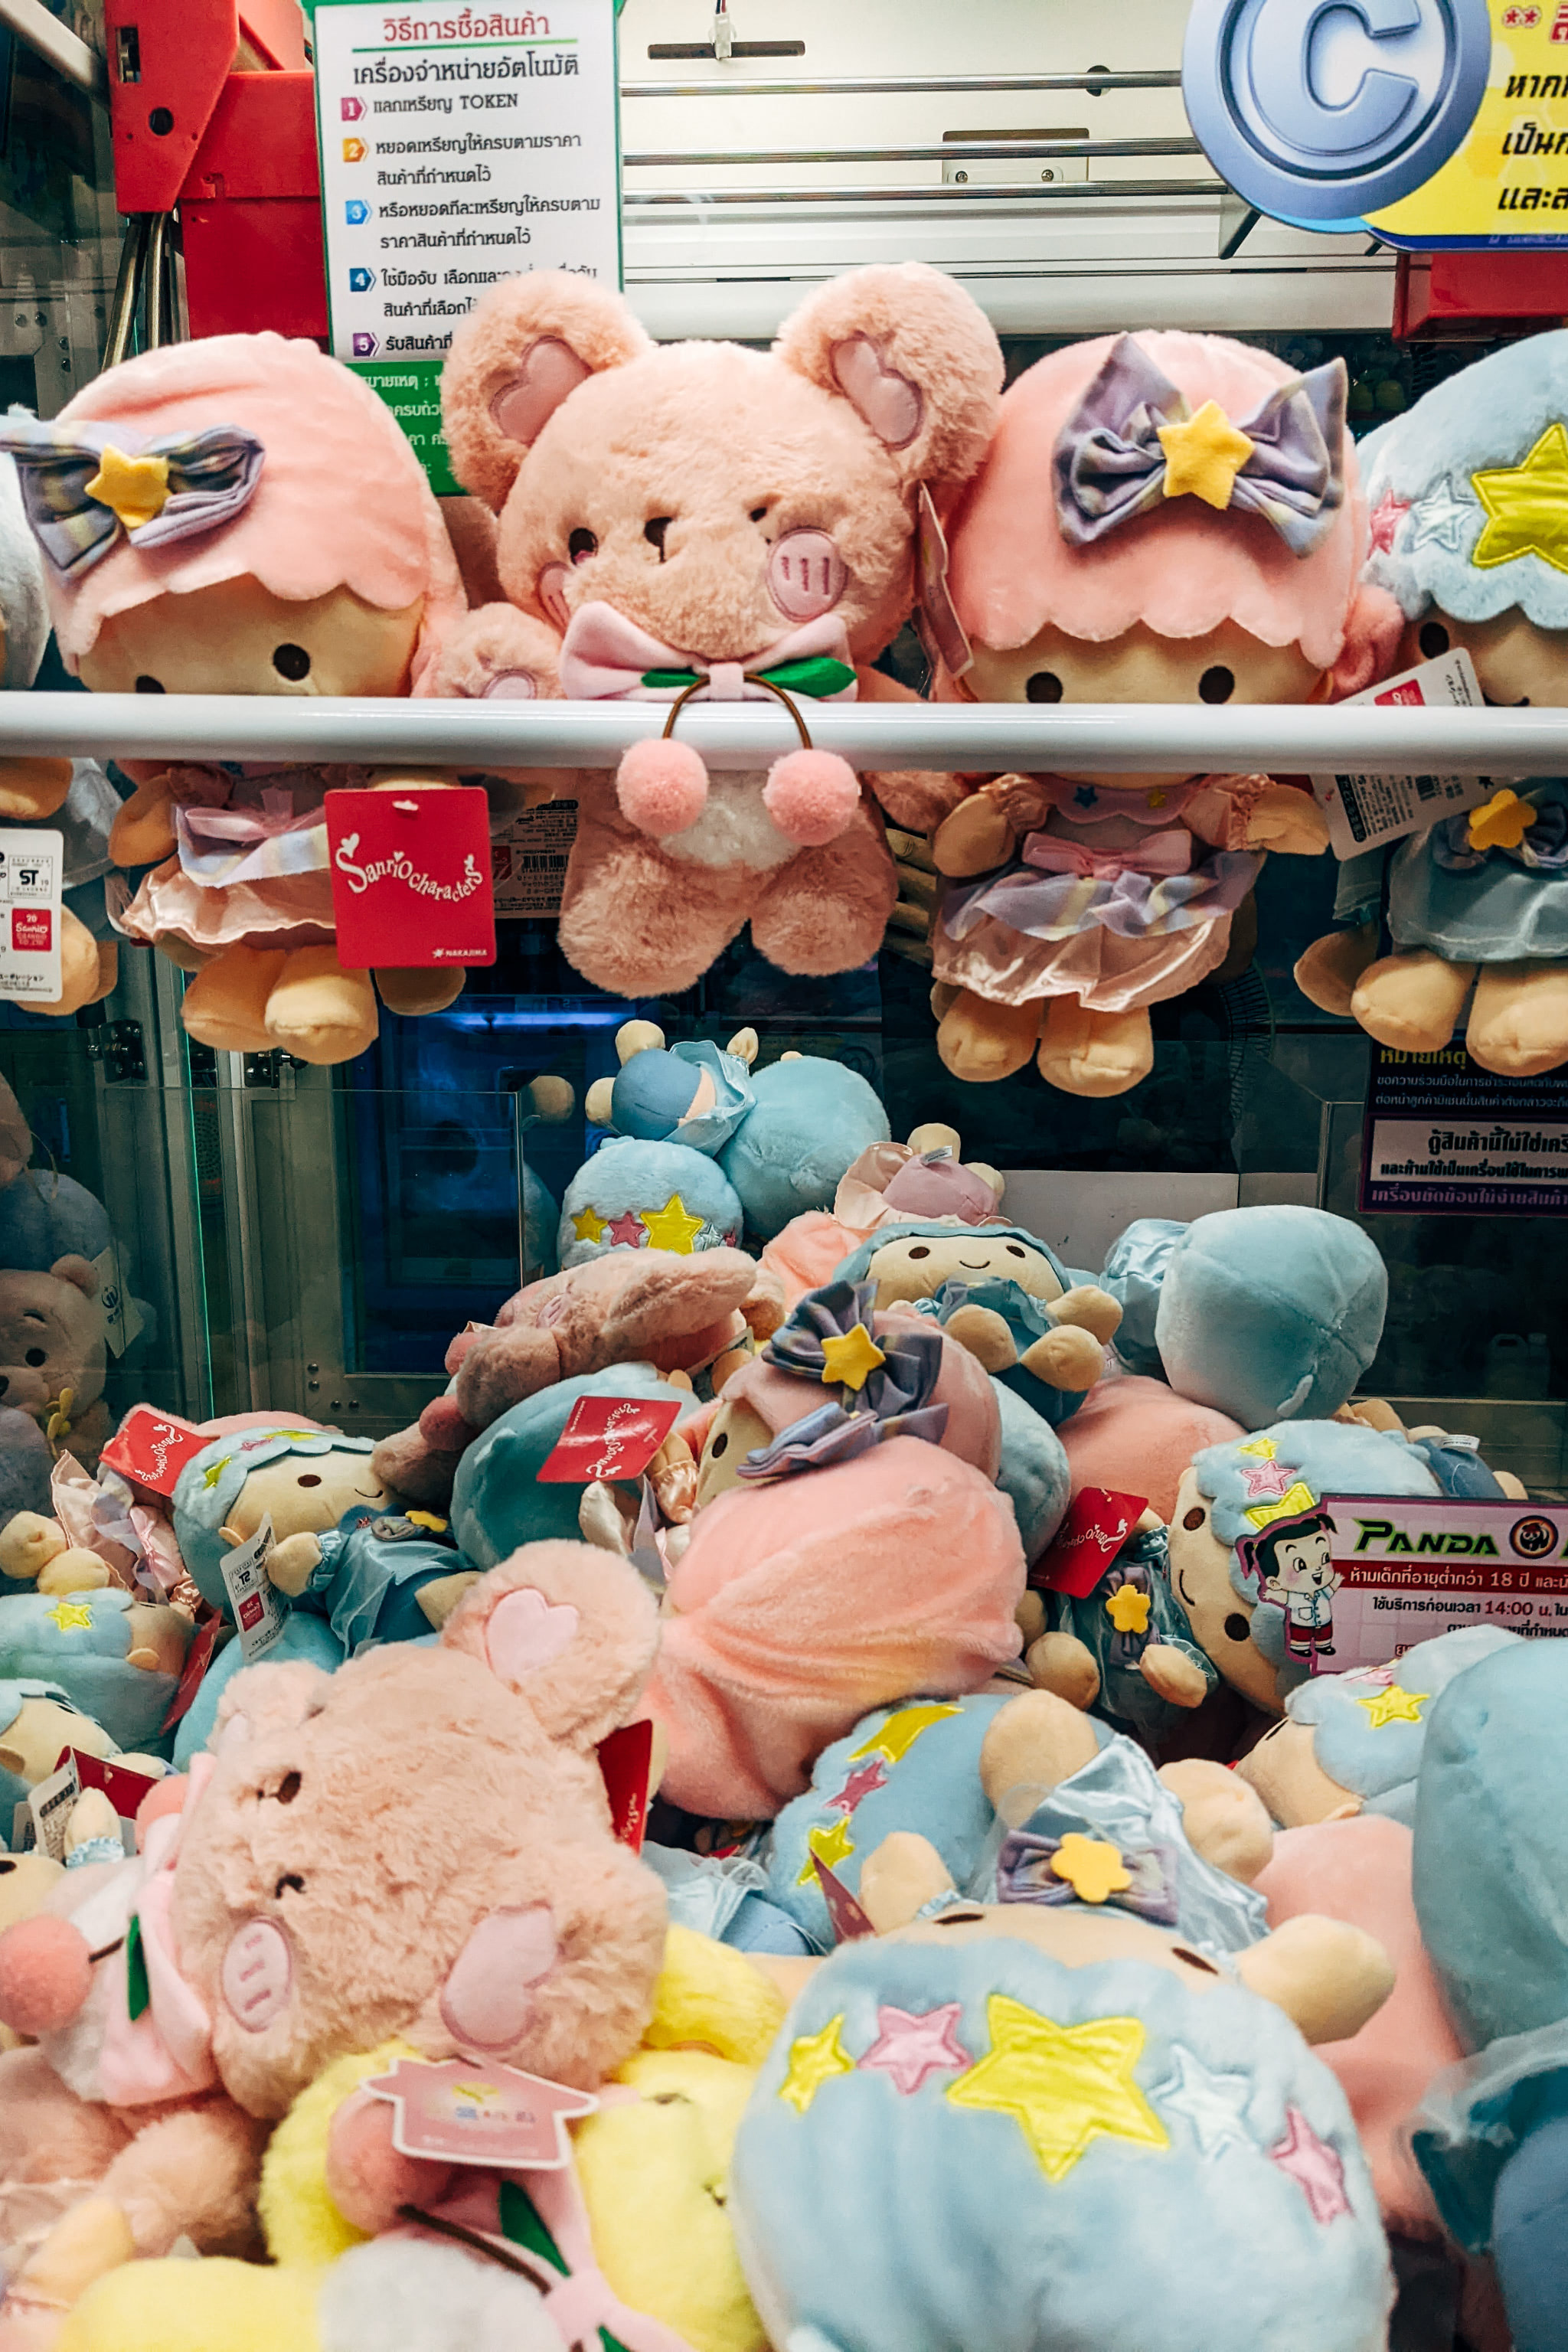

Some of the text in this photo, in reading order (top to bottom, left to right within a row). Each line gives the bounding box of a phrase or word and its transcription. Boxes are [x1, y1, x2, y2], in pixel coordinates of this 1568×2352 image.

[384, 8, 550, 41] วิธีการซื้อสินค้า
[354, 51, 579, 84] เครื่องจำหน่ายอัตโนมัติ
[374, 96, 452, 113] แลกเหรียญ
[460, 93, 518, 110] TOKEN
[376, 132, 582, 155] หยอดเหรียญให้ครบตามราคา
[377, 164, 492, 186] สินค้าที่กำหนดไว้
[381, 227, 531, 249] ราคาสินค้าที่กำหนดไว้
[381, 267, 436, 287] ใช้มือจับ
[19, 869, 39, 886] ST
[1352, 1517, 1501, 1557] PANDA
[1351, 1564, 1482, 1589] ห้ามเด็กที่อายุต่ำกว่า
[1491, 1572, 1513, 1588] 18
[1519, 1572, 1530, 1587] ปี
[1373, 1597, 1481, 1614] ใช้บริการก่อนเวลา
[1485, 1601, 1534, 1616] 14:00
